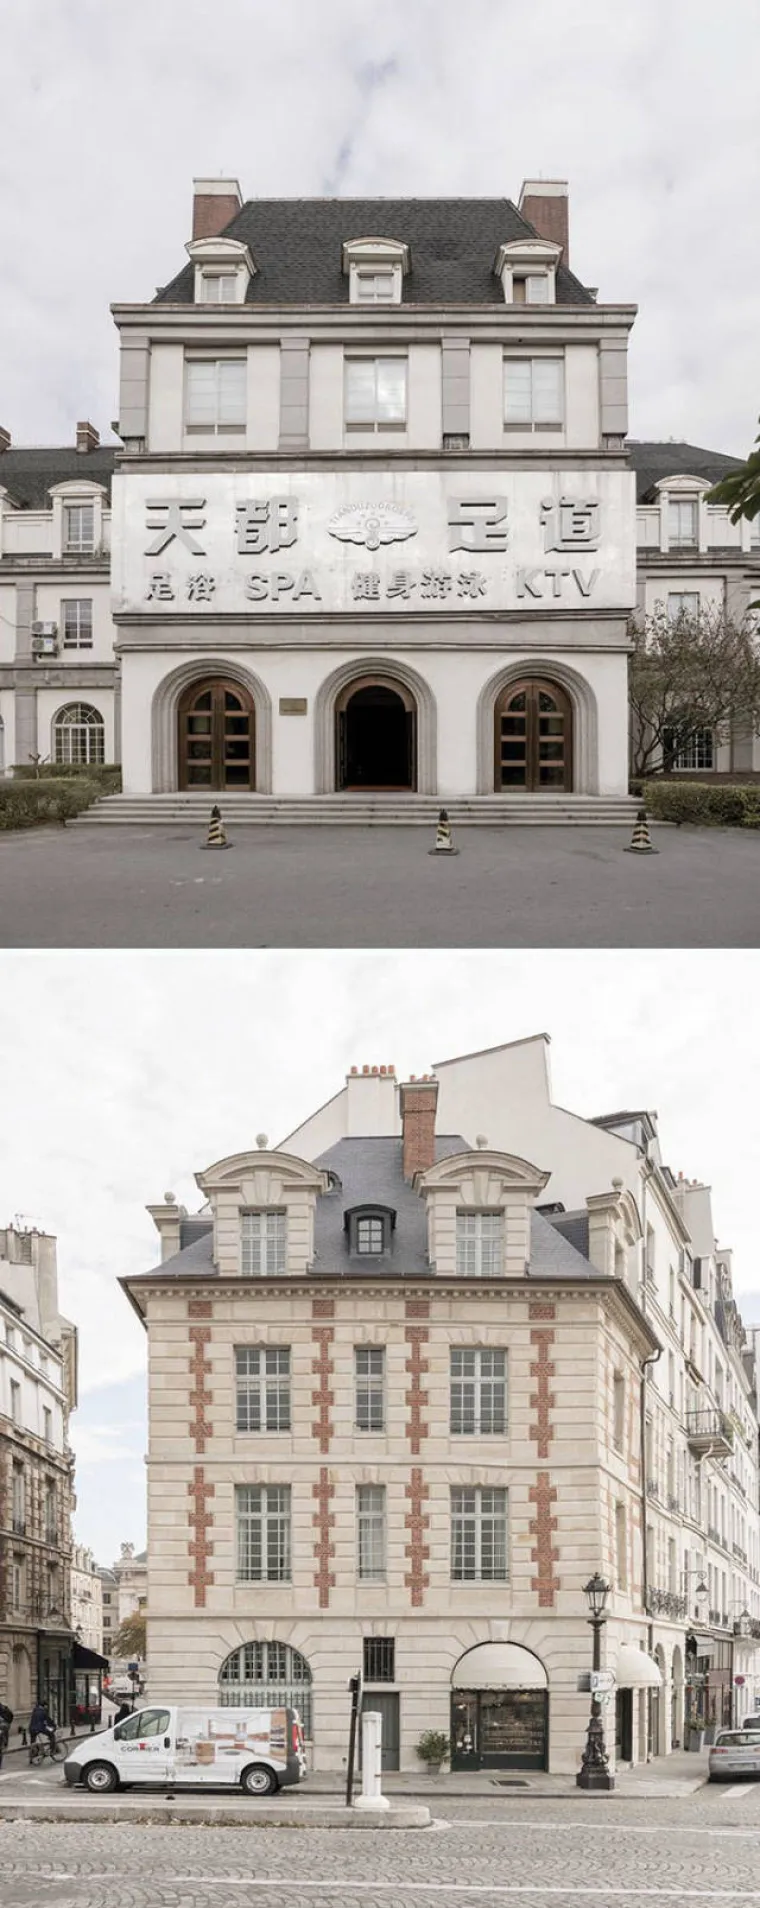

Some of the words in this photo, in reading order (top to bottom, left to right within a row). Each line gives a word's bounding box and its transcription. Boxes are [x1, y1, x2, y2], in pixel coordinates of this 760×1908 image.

[144, 496, 299, 556] 天都
[448, 496, 601, 554] 足道
[146, 571, 215, 601] 足浴
[246, 570, 322, 601] SPA
[352, 570, 489, 600] 健身游泳
[516, 568, 600, 598] KTV
